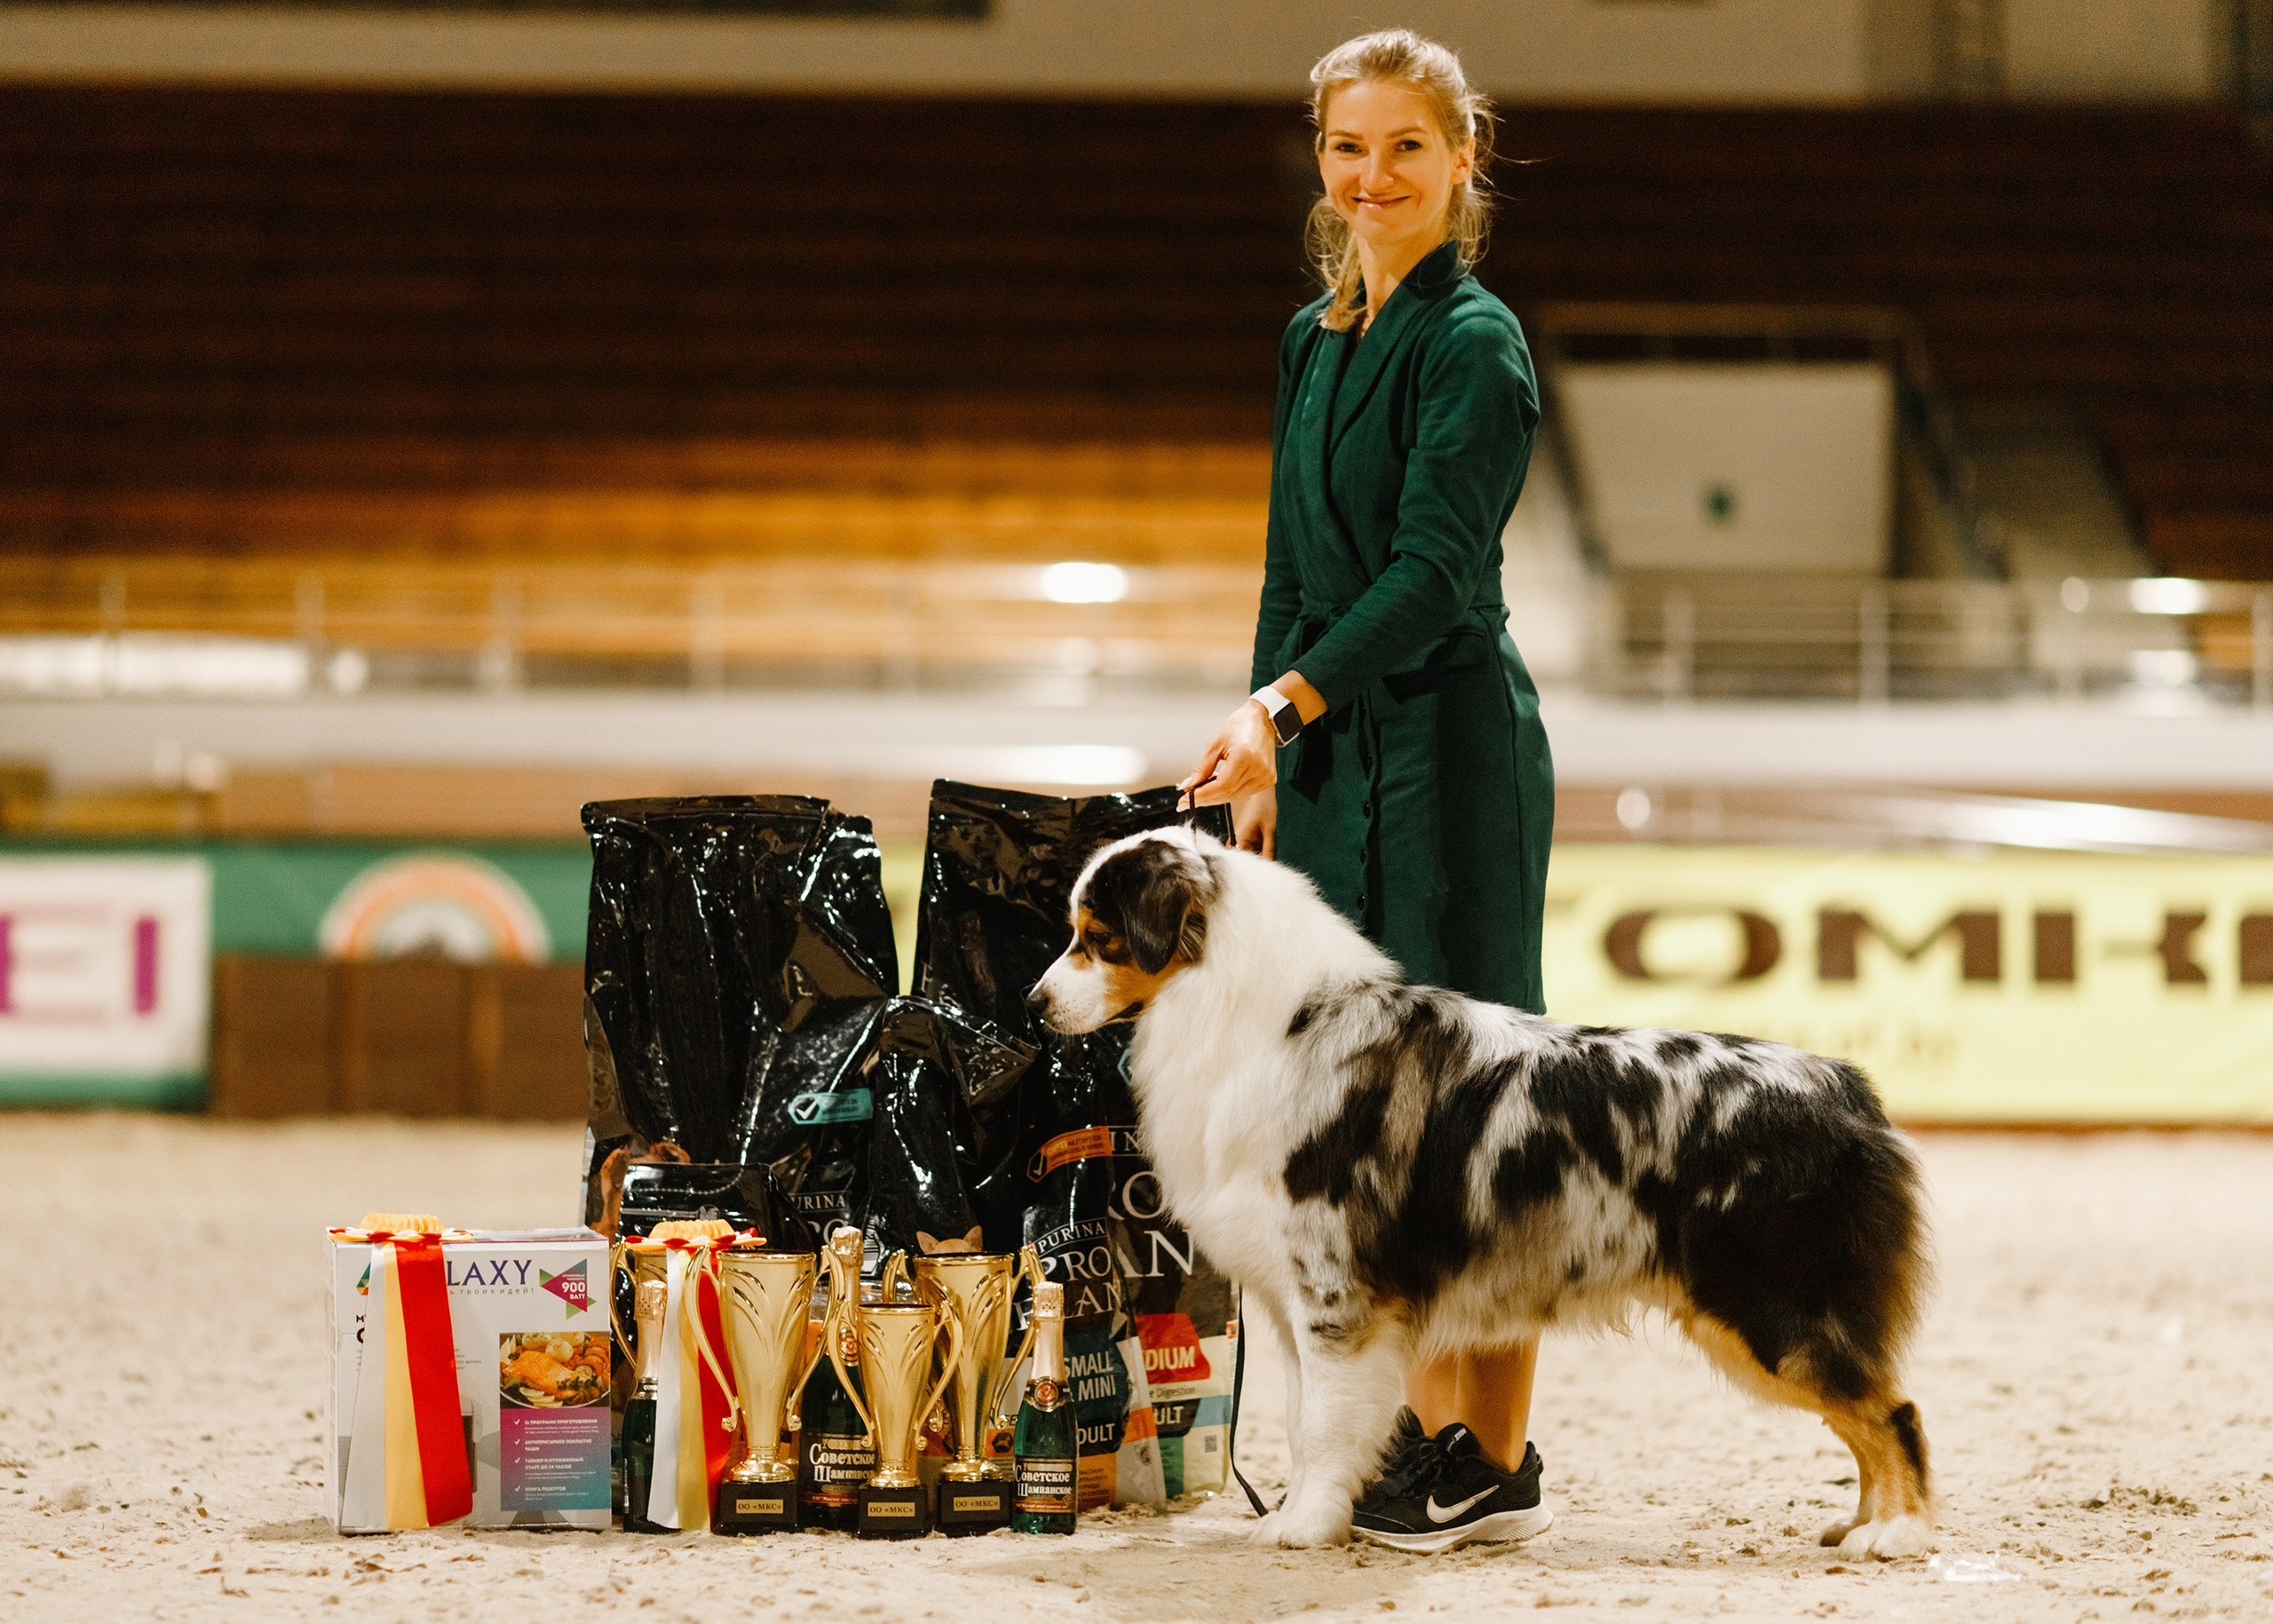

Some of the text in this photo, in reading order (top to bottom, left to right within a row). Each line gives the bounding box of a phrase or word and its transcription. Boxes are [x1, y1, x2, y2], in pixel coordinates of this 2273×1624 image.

[1037, 1221, 1105, 1254] PURINA
[446, 1259, 533, 1287] LAXY
[561, 1281, 586, 1294] 900
[1144, 1345, 1196, 1372] DIUM
[1078, 1374, 1117, 1402] MINI
[1156, 1386, 1196, 1399] Digestion
[1154, 1406, 1184, 1426] ULT
[1077, 1422, 1116, 1446] DULT
[1015, 1464, 1071, 1483] Советское
[1017, 1483, 1073, 1497] Шампанское
